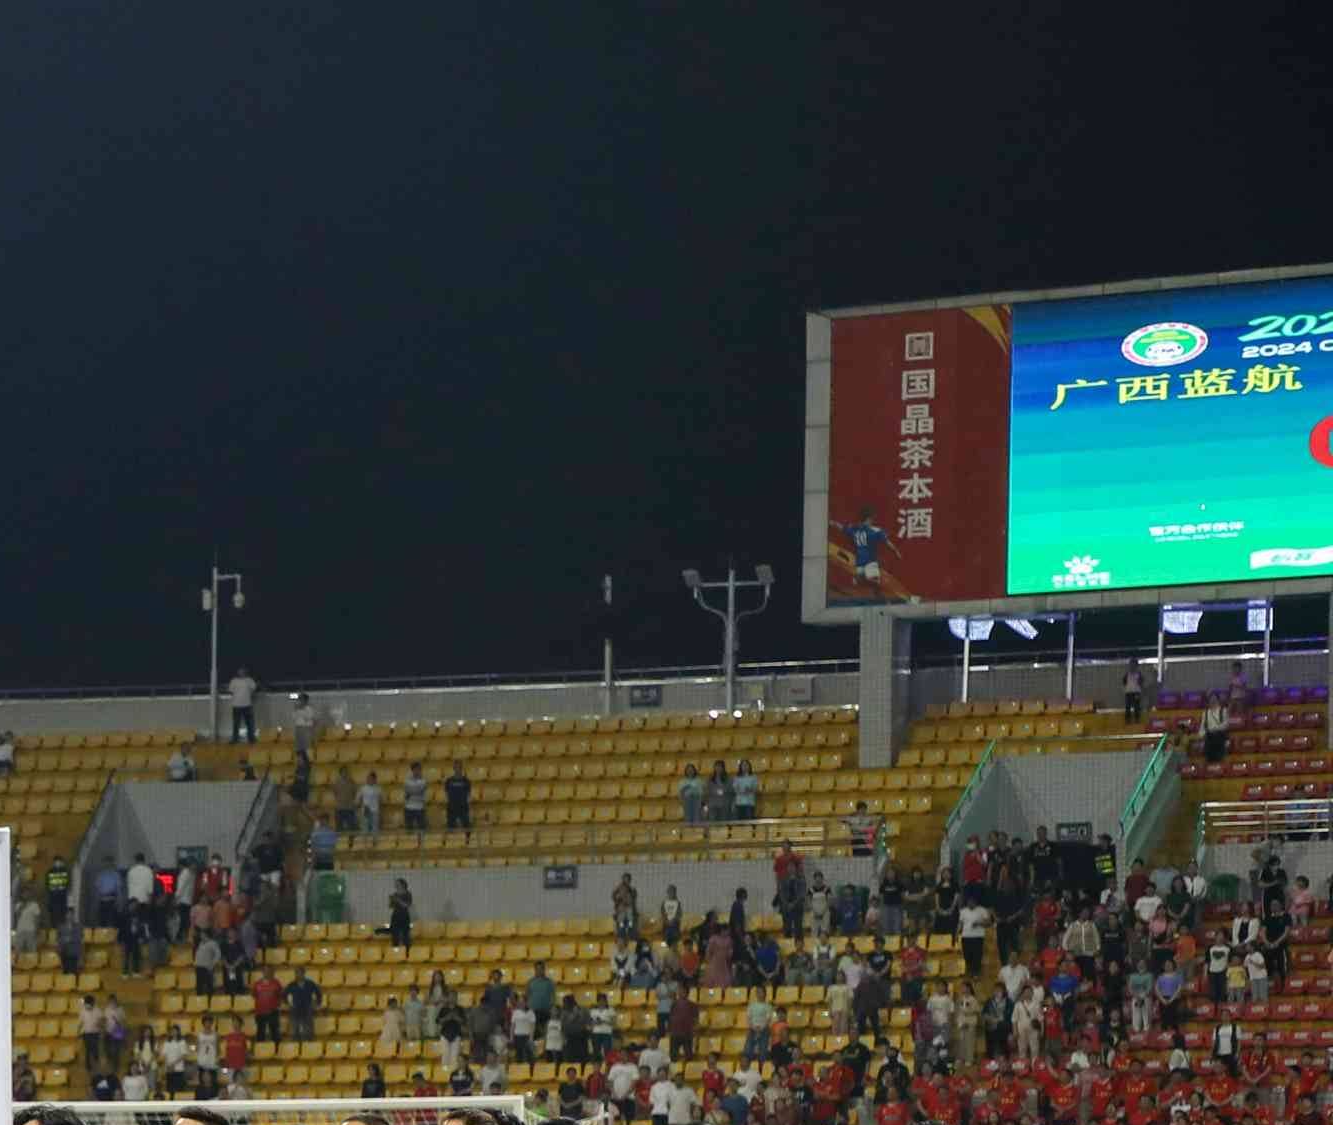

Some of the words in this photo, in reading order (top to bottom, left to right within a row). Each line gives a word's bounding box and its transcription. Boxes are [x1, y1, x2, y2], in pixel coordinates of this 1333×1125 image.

[1242, 341, 1313, 359] 2024
[1050, 364, 1303, 410] 广西蓝航
